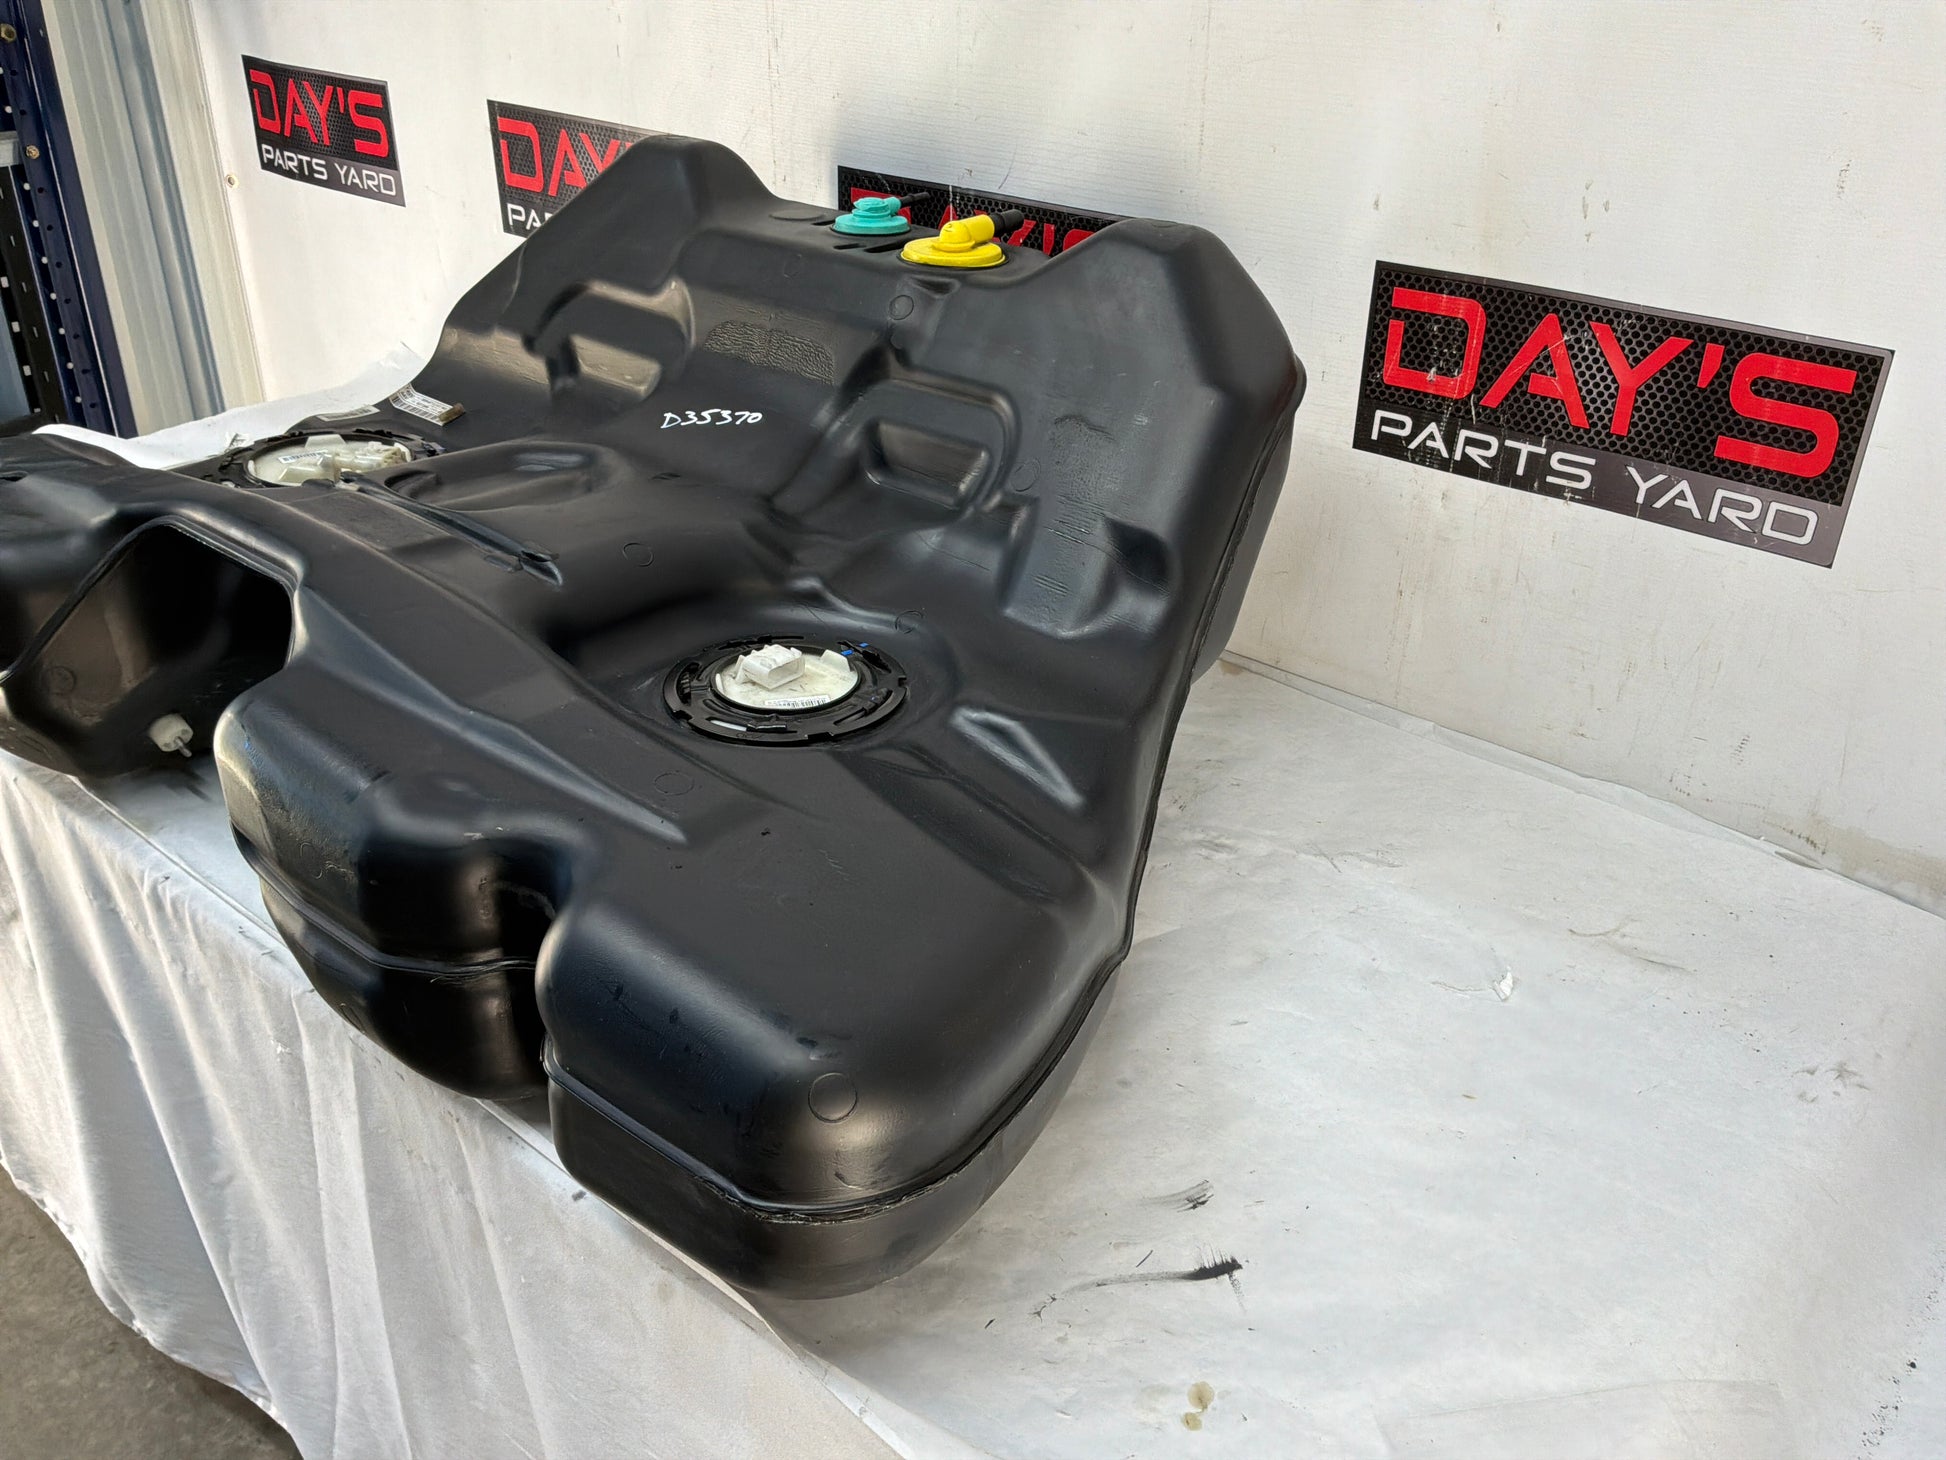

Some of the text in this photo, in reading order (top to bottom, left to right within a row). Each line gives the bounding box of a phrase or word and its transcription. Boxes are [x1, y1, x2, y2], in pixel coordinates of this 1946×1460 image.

[249, 68, 389, 158] DAY'S
[262, 143, 397, 197] PARTS YARD
[660, 408, 763, 429] D35370
[1382, 286, 1858, 479] DAY'S
[1370, 409, 1820, 546] PARTS YARD
